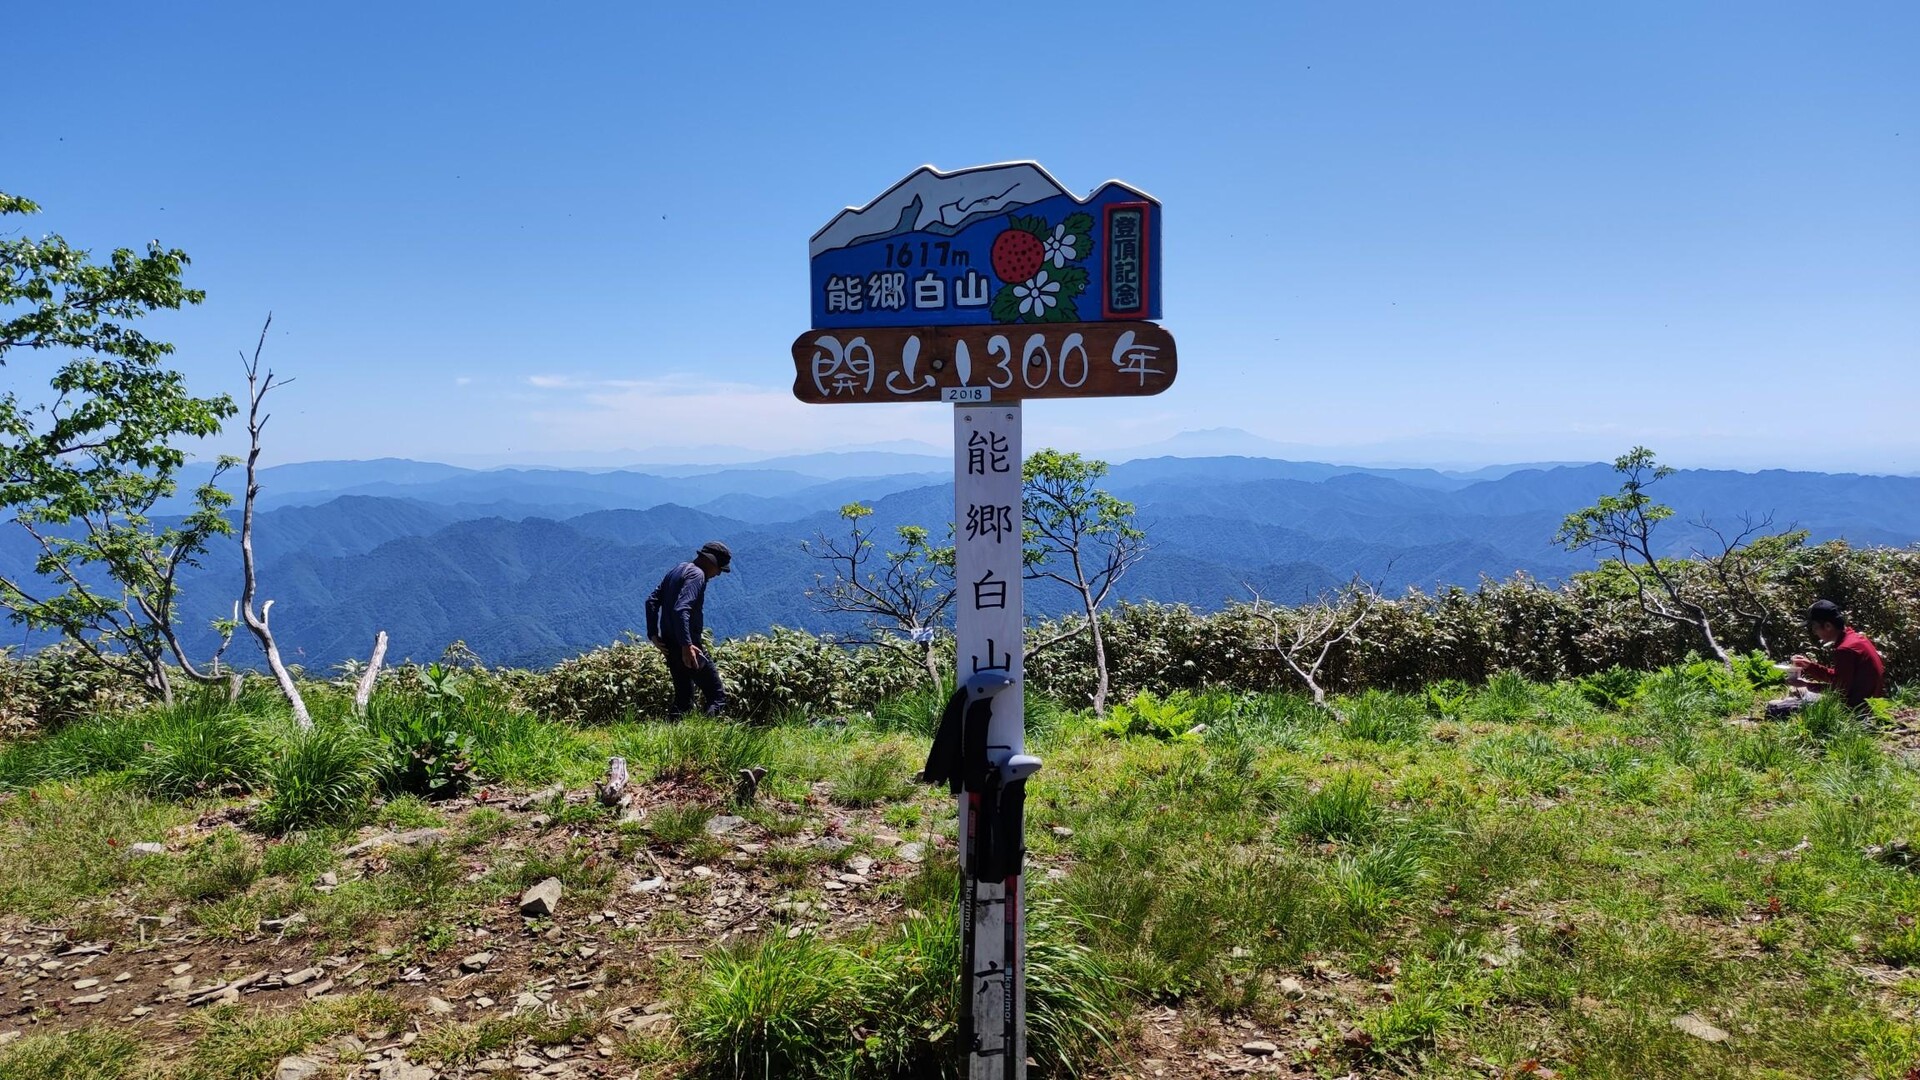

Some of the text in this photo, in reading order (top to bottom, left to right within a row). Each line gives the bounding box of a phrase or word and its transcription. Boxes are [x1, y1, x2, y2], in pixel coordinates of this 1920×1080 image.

[885, 241, 970, 268] 1617m
[1113, 216, 1137, 307] 登頂記念
[826, 271, 989, 311] 能郷白山
[948, 388, 983, 401] 2018
[965, 430, 1012, 675] 能郷白山
[964, 887, 974, 932] karrimor
[1004, 974, 1013, 1024] karrimor
